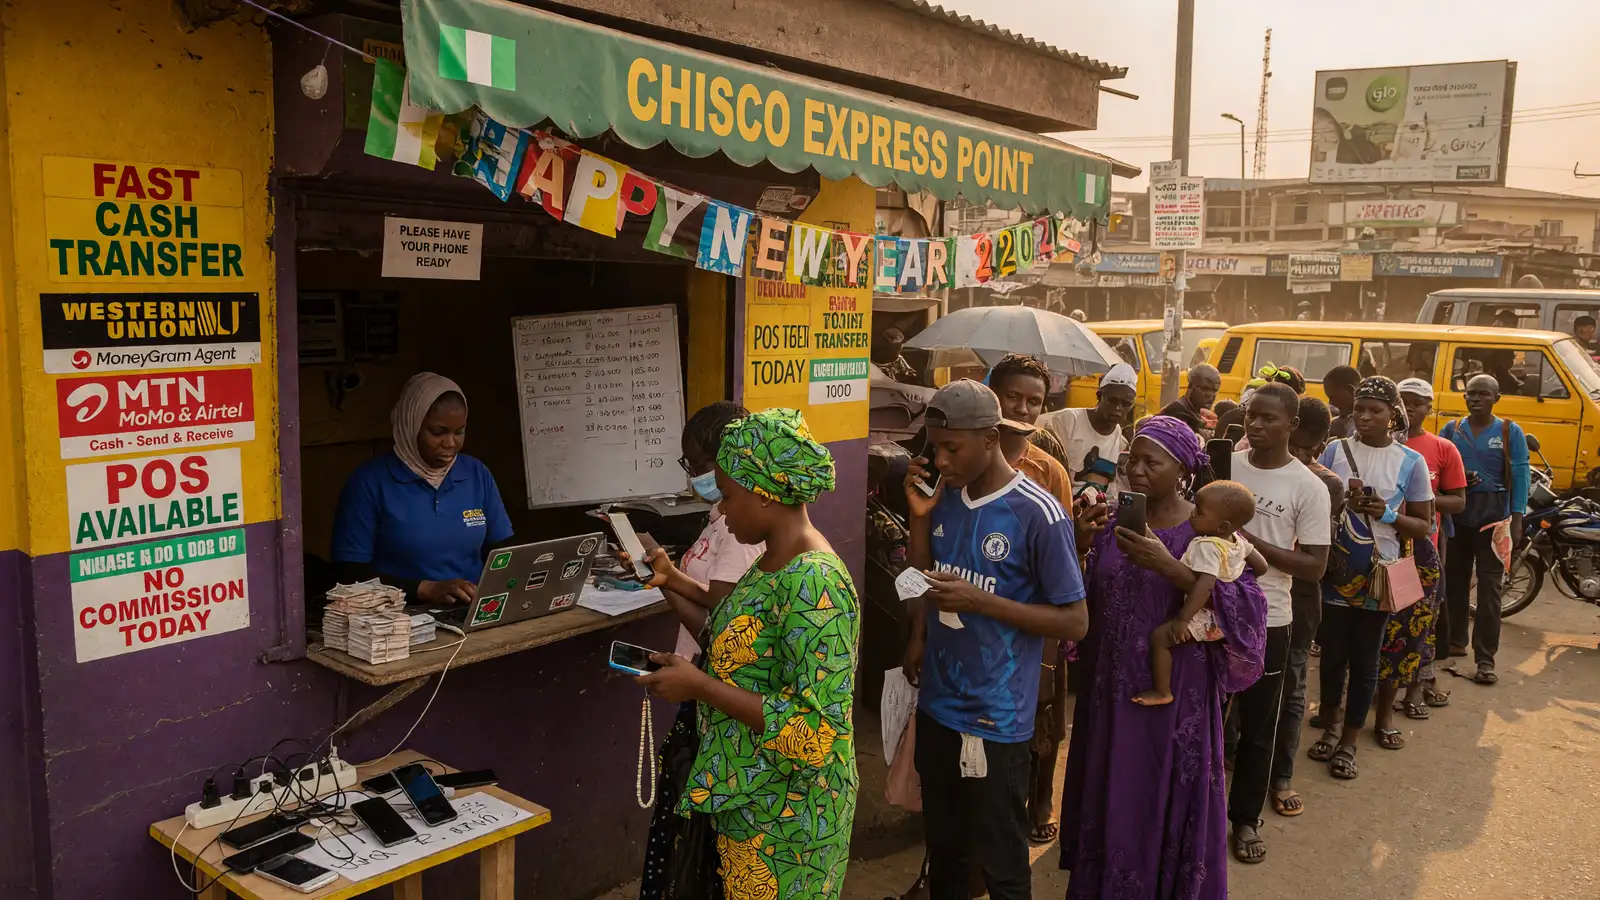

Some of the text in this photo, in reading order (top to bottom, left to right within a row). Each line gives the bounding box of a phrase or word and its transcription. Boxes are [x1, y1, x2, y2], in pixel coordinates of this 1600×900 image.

[1372, 86, 1397, 103] glo
[627, 57, 1034, 195] CHISCO EXPRESS POINT
[93, 163, 200, 201] FAST
[95, 201, 199, 239] CASH
[400, 225, 471, 240] PLEASE HAVE
[50, 239, 244, 277] TRANSFER
[400, 240, 468, 254] YOUR PHONE
[710, 206, 829, 280] NEW
[842, 233, 948, 287] YEAR
[416, 256, 451, 268] READY
[61, 302, 195, 321] WESTERN
[107, 321, 195, 339] UNION
[754, 325, 779, 350] POS
[814, 332, 868, 349] TRANSFER
[96, 347, 236, 367] MoneyGram Agent
[751, 359, 806, 386] TODAY
[118, 376, 205, 409] MTN
[826, 383, 851, 398] 1000
[119, 402, 243, 427] MoMo & Airtel
[89, 438, 124, 451] Cash
[136, 433, 169, 447] Send
[173, 432, 182, 443] &
[187, 428, 234, 442] Receive
[106, 455, 209, 505] POS
[76, 492, 239, 544] AVAILABLE
[143, 567, 184, 592] NO
[79, 578, 244, 629] COMMISSION
[119, 609, 212, 647] TODAY
